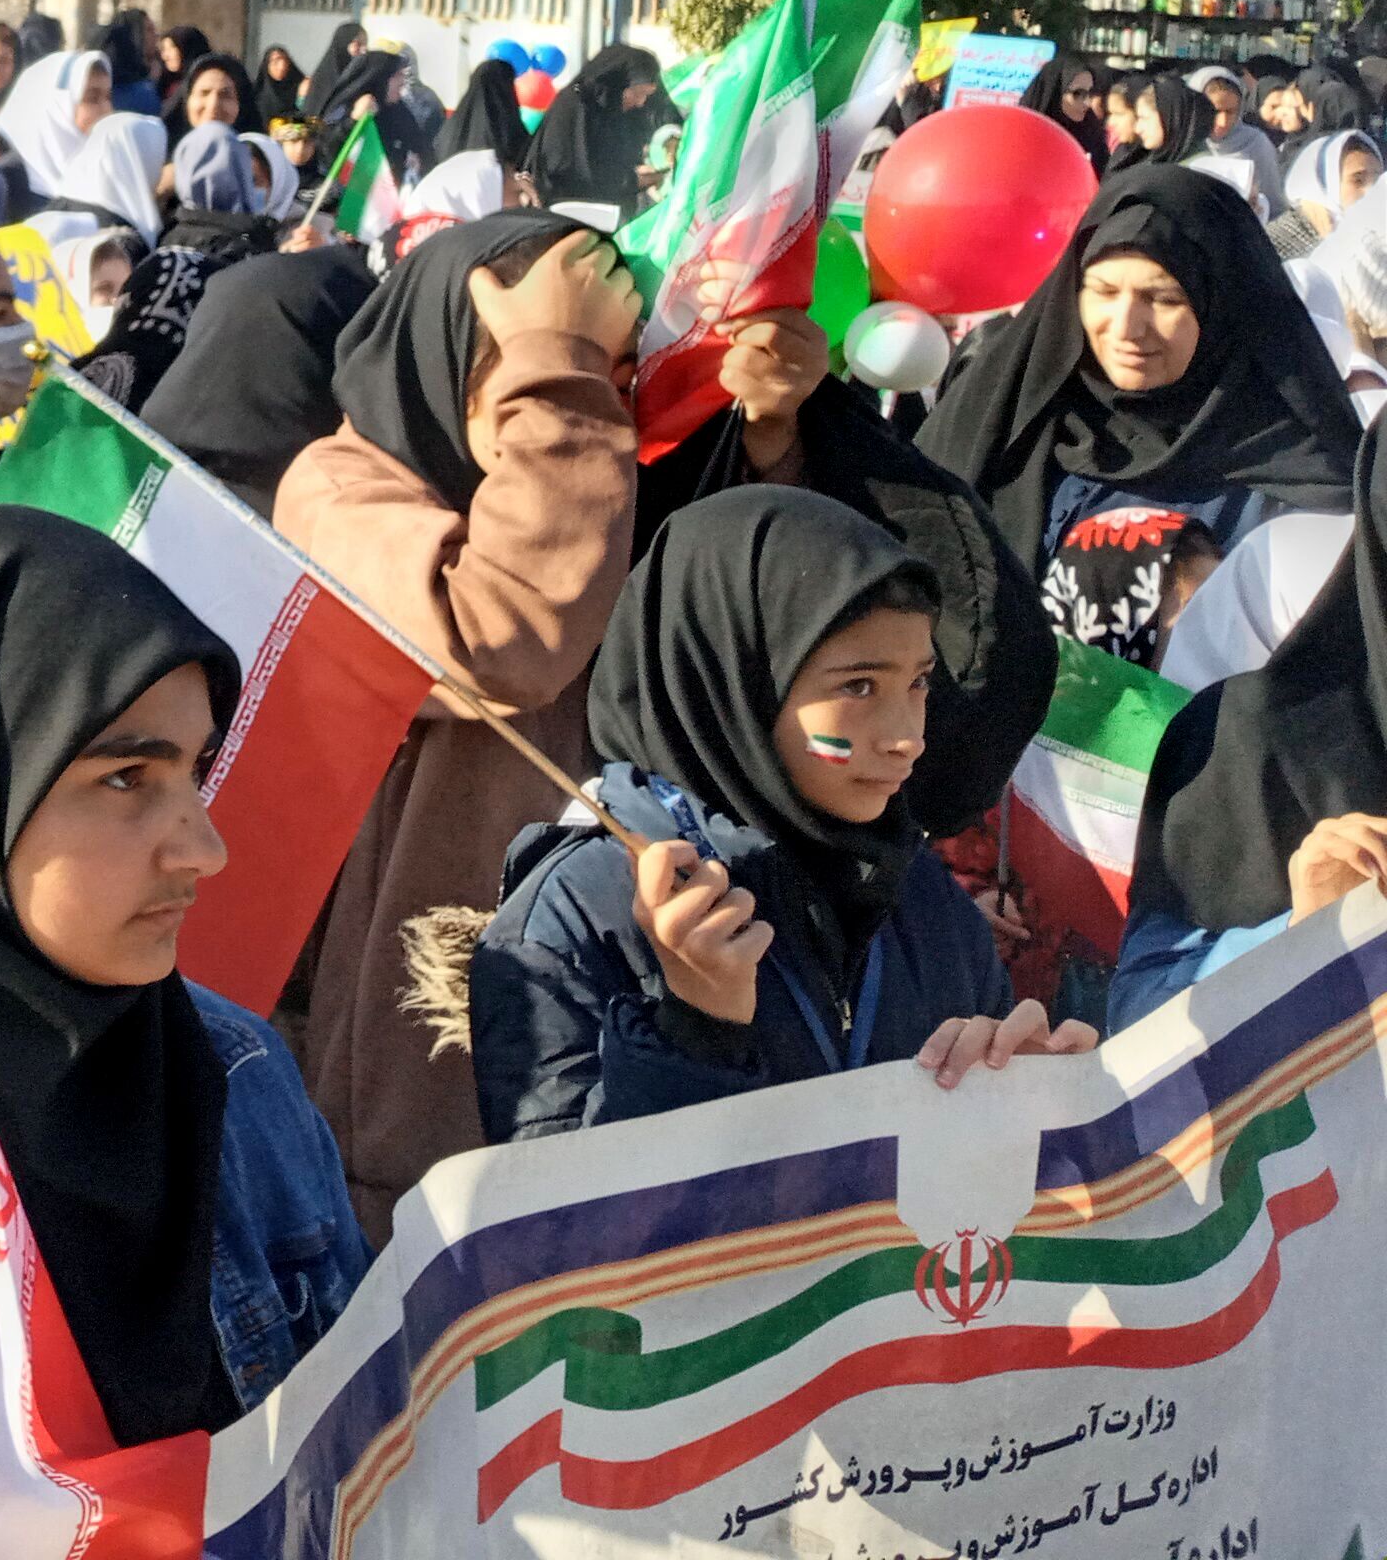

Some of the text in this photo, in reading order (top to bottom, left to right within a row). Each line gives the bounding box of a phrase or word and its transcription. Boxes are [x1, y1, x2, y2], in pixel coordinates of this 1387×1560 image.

[968, 1402, 1106, 1481] آموزش
[1103, 1394, 1177, 1440] وزارت
[717, 1463, 825, 1541] کشور
[827, 1456, 951, 1503] پرورش
[1099, 1470, 1168, 1526] کل
[1167, 1445, 1218, 1507] اداره
[981, 1483, 1102, 1560] آموزش
